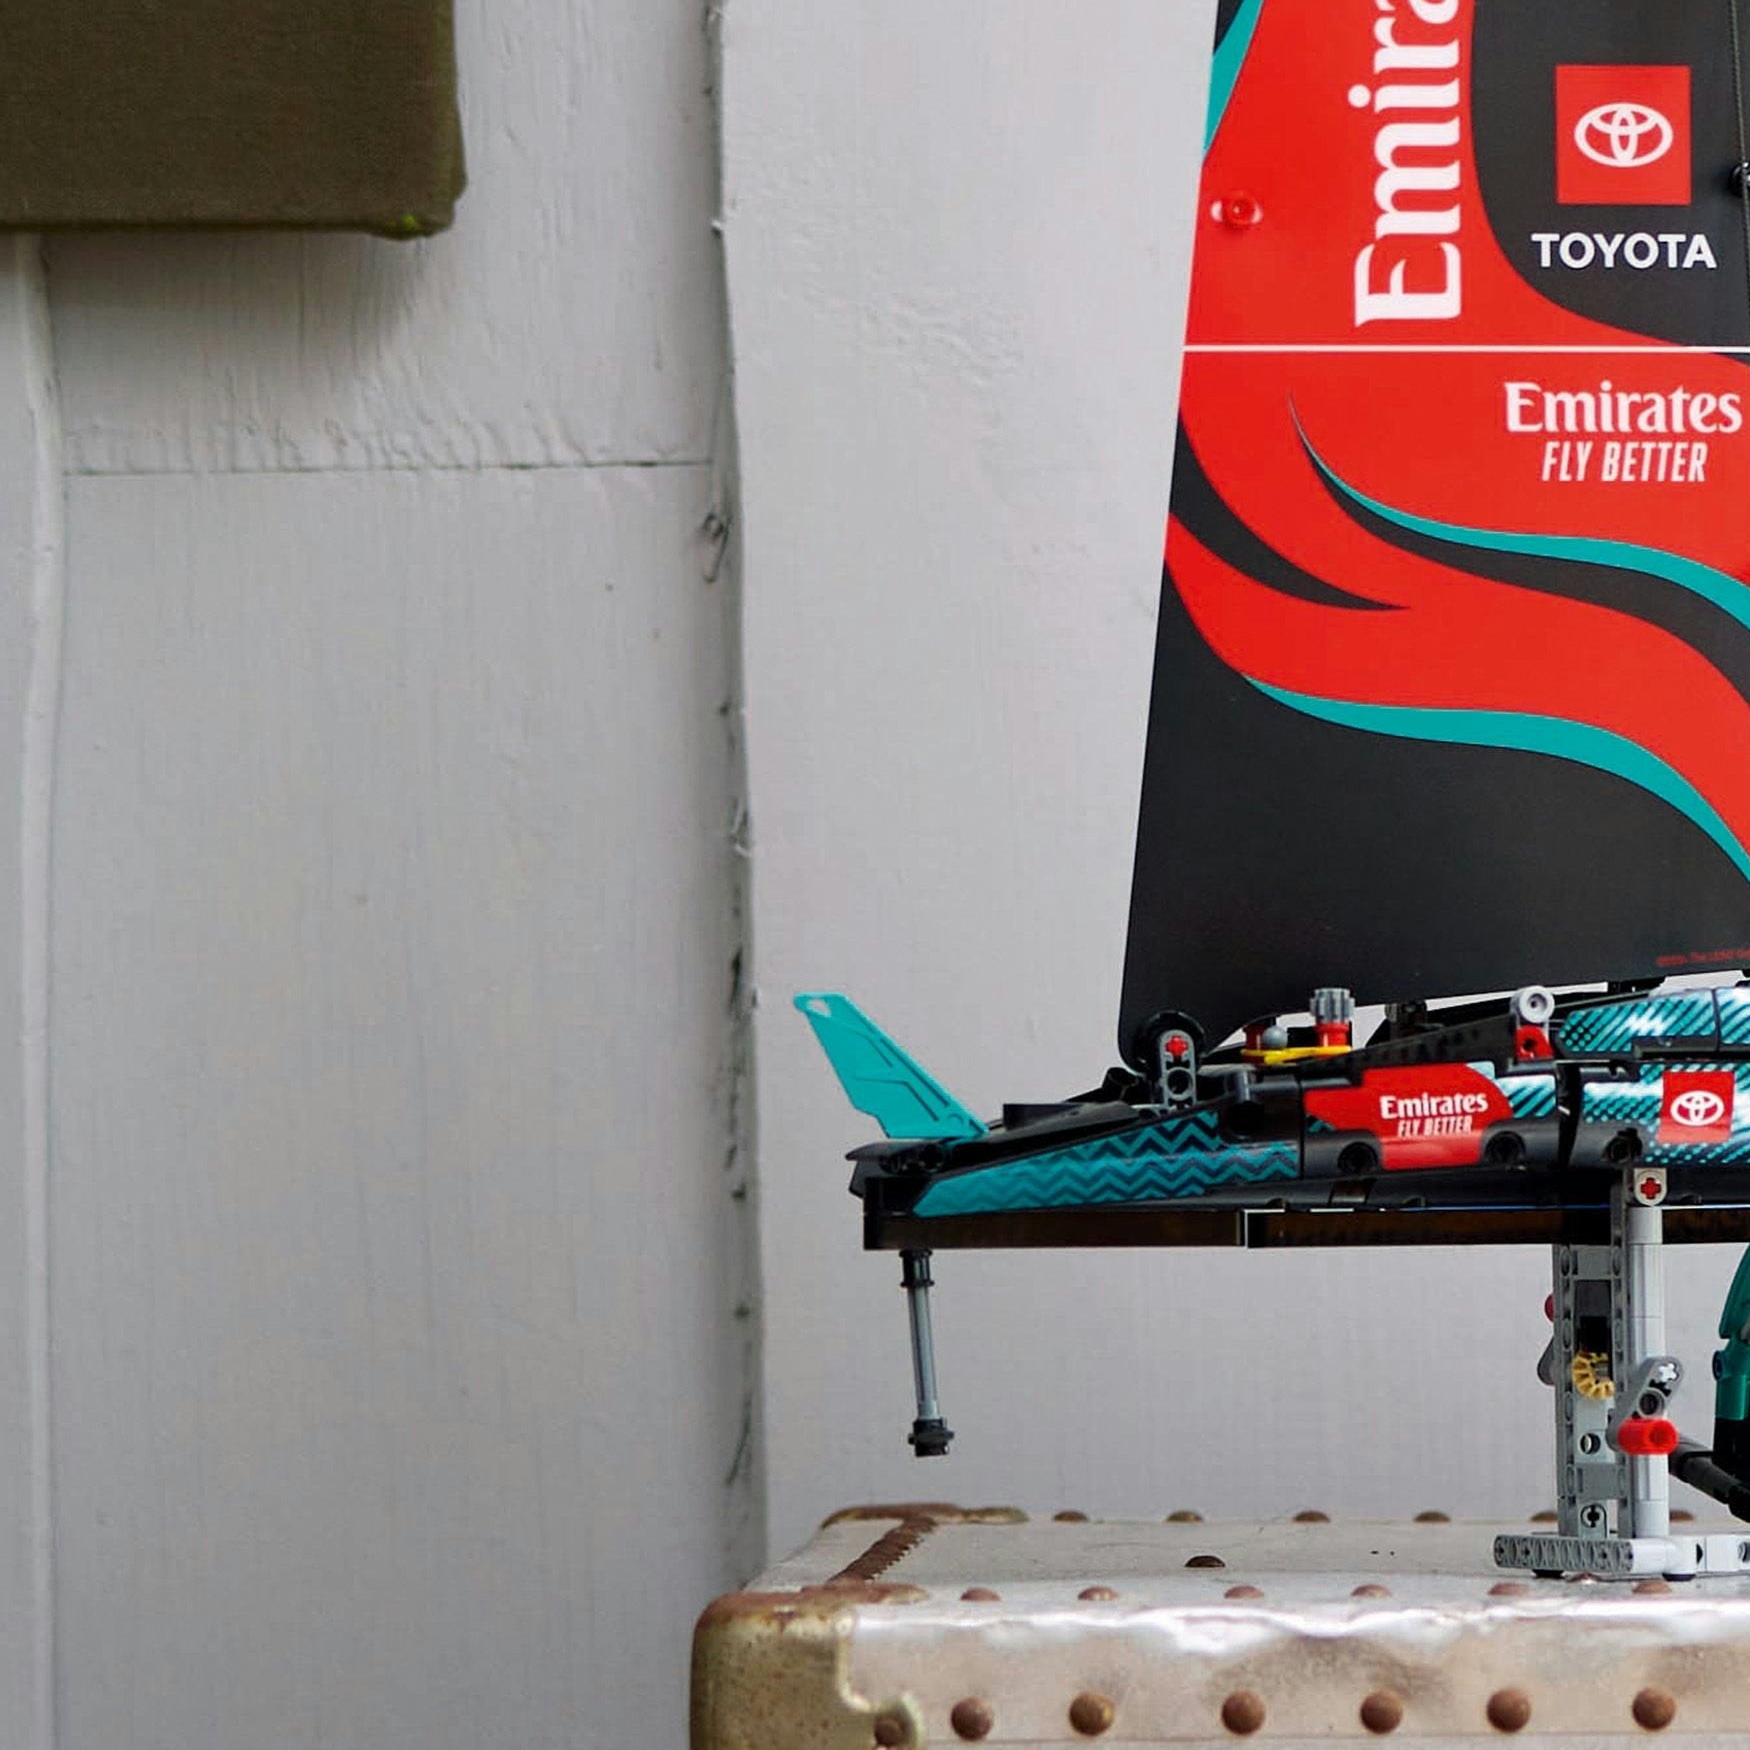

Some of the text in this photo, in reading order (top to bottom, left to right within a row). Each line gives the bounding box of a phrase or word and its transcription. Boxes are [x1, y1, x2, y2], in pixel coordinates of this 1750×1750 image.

[1531, 232, 1717, 269] TOYOTA
[1503, 379, 1743, 434] Emirates
[1541, 441, 1708, 482] FLY BETTER
[1380, 1092, 1488, 1120] Emirates
[1397, 1115, 1473, 1139] FLY BETTER
